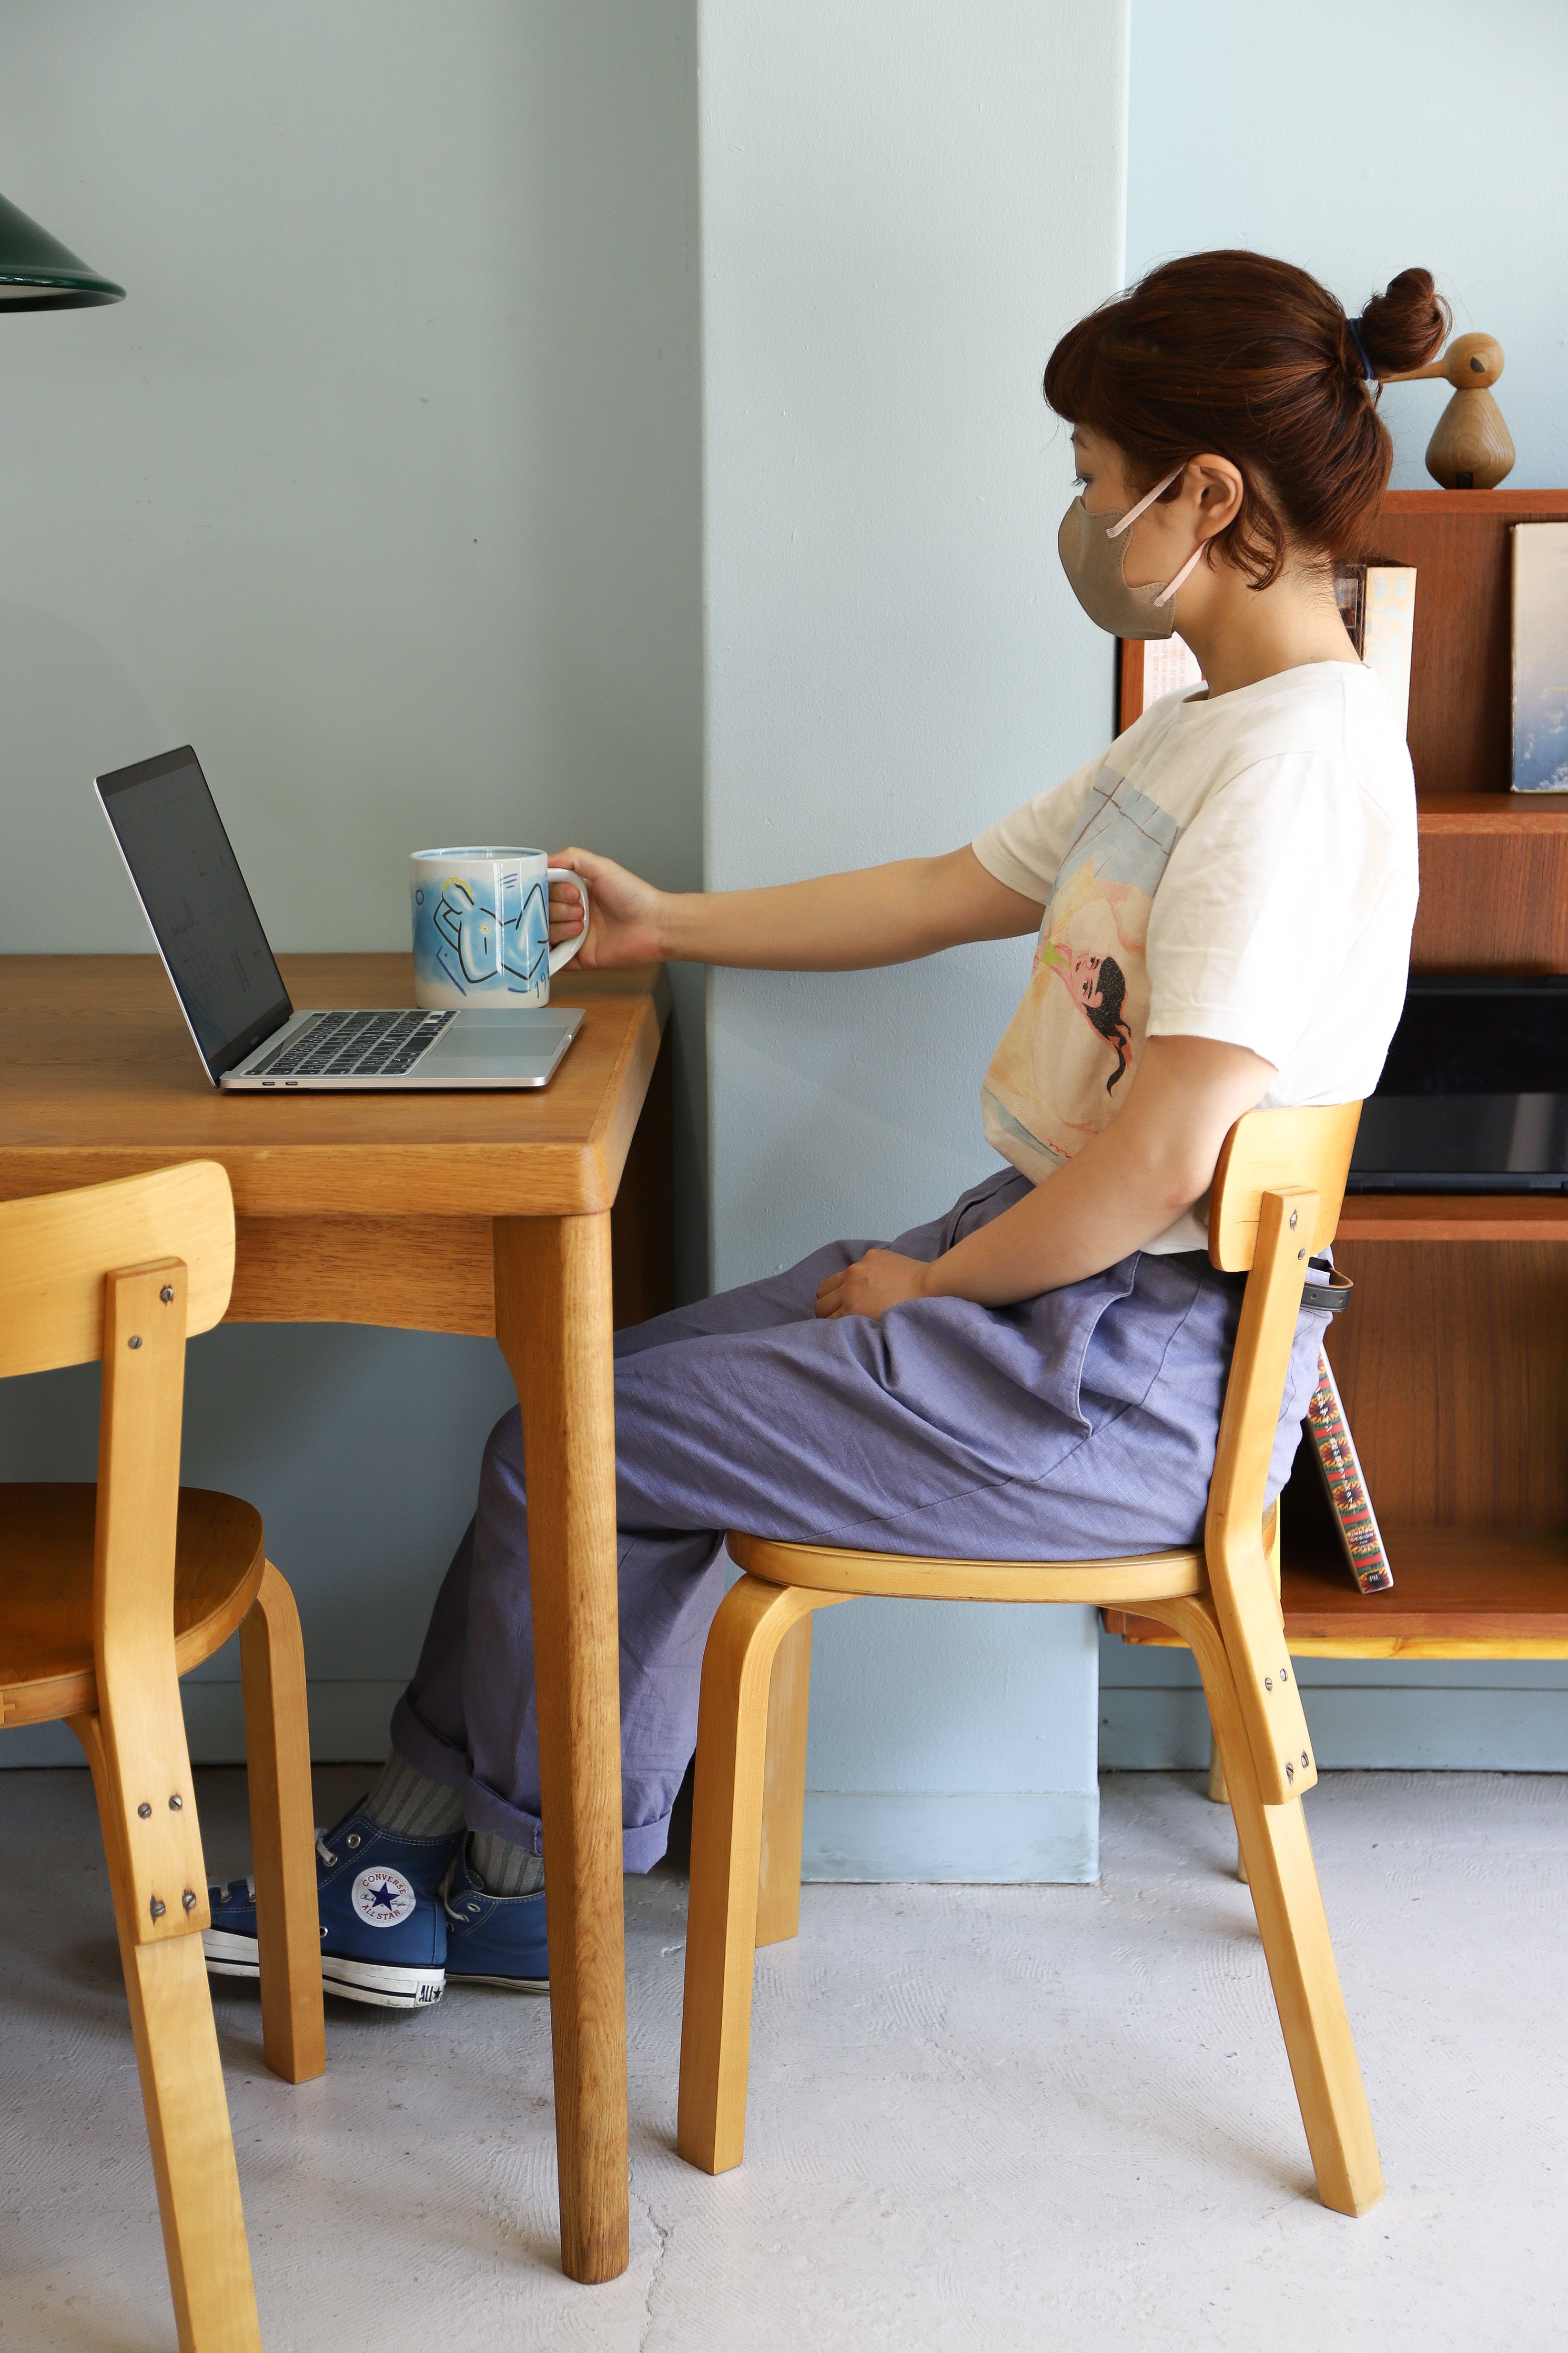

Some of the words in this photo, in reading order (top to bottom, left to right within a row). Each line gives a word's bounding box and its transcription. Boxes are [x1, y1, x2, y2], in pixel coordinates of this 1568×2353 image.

[1171, 659, 1177, 667] DE
[362, 1874, 407, 1894] CONVERSE
[362, 1904, 375, 1917] ALL
[377, 1910, 401, 1920] STAR
[418, 1985, 434, 2002] ALL
